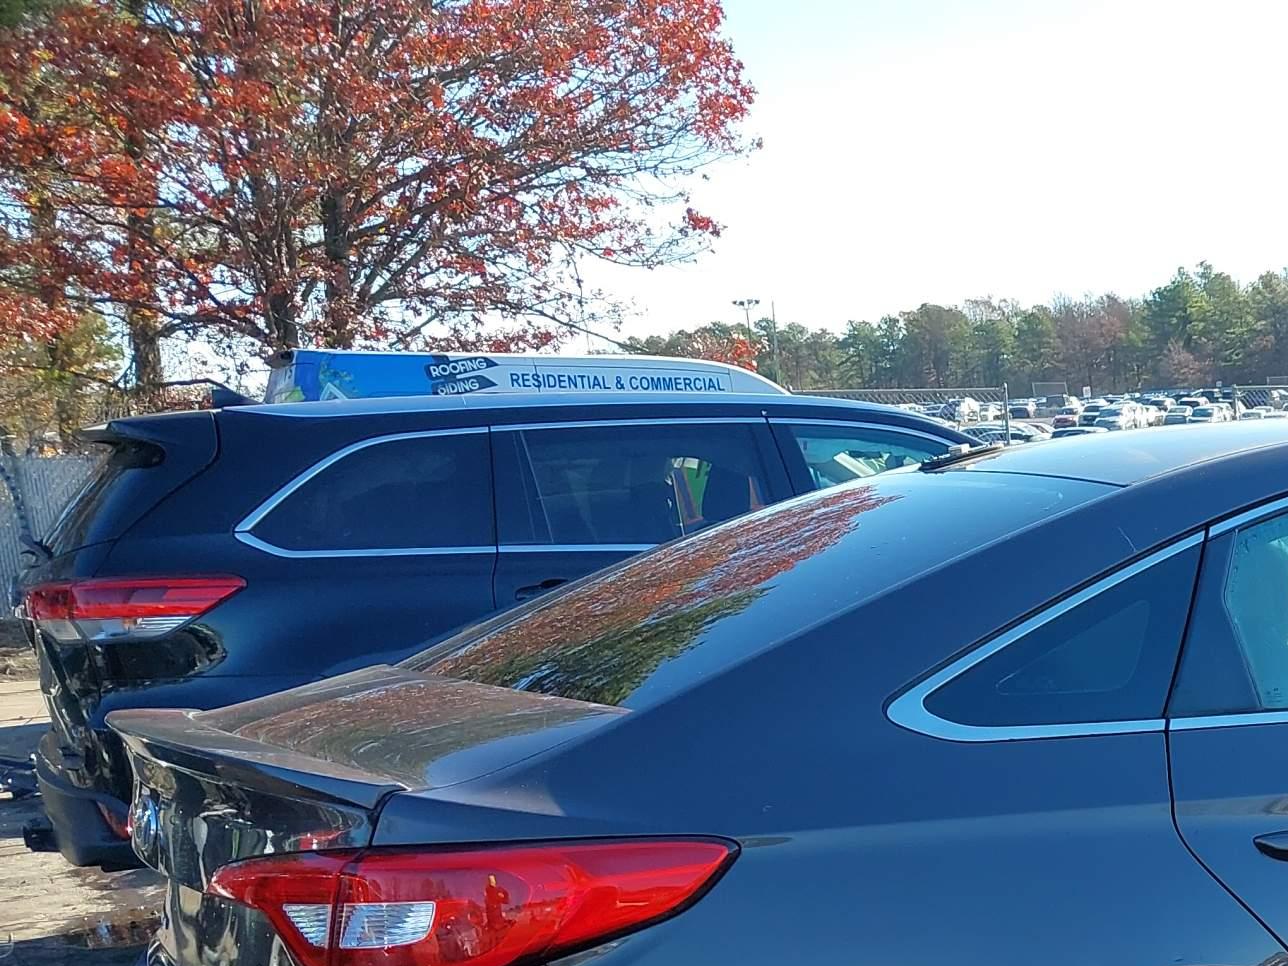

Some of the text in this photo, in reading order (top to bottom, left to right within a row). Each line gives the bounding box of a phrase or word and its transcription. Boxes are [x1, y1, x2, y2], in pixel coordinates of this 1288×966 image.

[429, 358, 487, 378] ROOFING
[509, 372, 726, 392] RESIDENTIAL & COMMERCIAL
